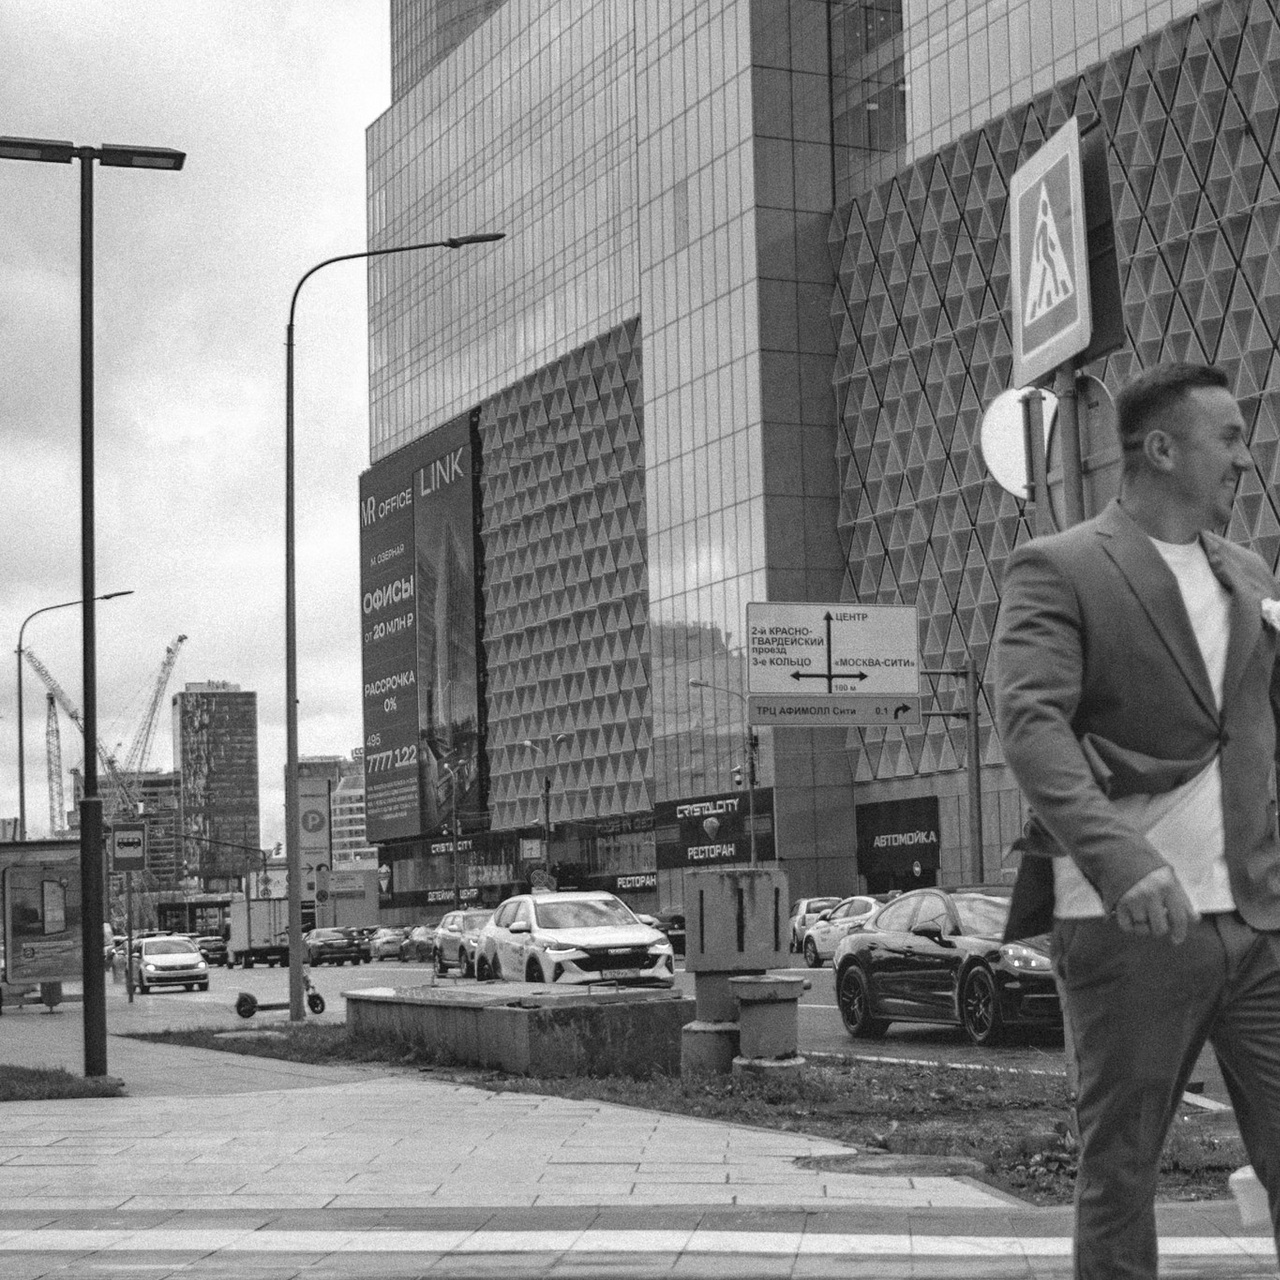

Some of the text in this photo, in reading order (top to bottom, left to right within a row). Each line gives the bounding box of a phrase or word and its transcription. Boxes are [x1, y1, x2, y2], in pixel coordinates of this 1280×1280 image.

[421, 446, 464, 497] LINK
[361, 487, 413, 527] MR OFFICE
[363, 574, 414, 614] ОФИСЫ
[835, 612, 868, 622] ЦЕНТР
[373, 621, 386, 640] 20
[386, 615, 406, 635] МЛН
[769, 626, 813, 636] КРАСНО-
[751, 635, 825, 647] ГВАРДЕЙСКИЙ
[751, 646, 787, 656] проезд
[752, 657, 812, 668] 3-е КОЛЬЦО
[834, 657, 916, 668] «МОСКВА-СИТИ»
[364, 670, 415, 698] РАССРОЧКА
[834, 684, 849, 692] 100
[383, 696, 397, 712] 0%
[756, 706, 889, 716] ТРЦ АФИМОЛЛ Сити 0.1
[366, 732, 381, 747] 495
[873, 829, 938, 848] АВТОМОЙКА
[687, 843, 736, 860] РЕСТОРАН
[616, 874, 657, 890] РЕСТОРАН
